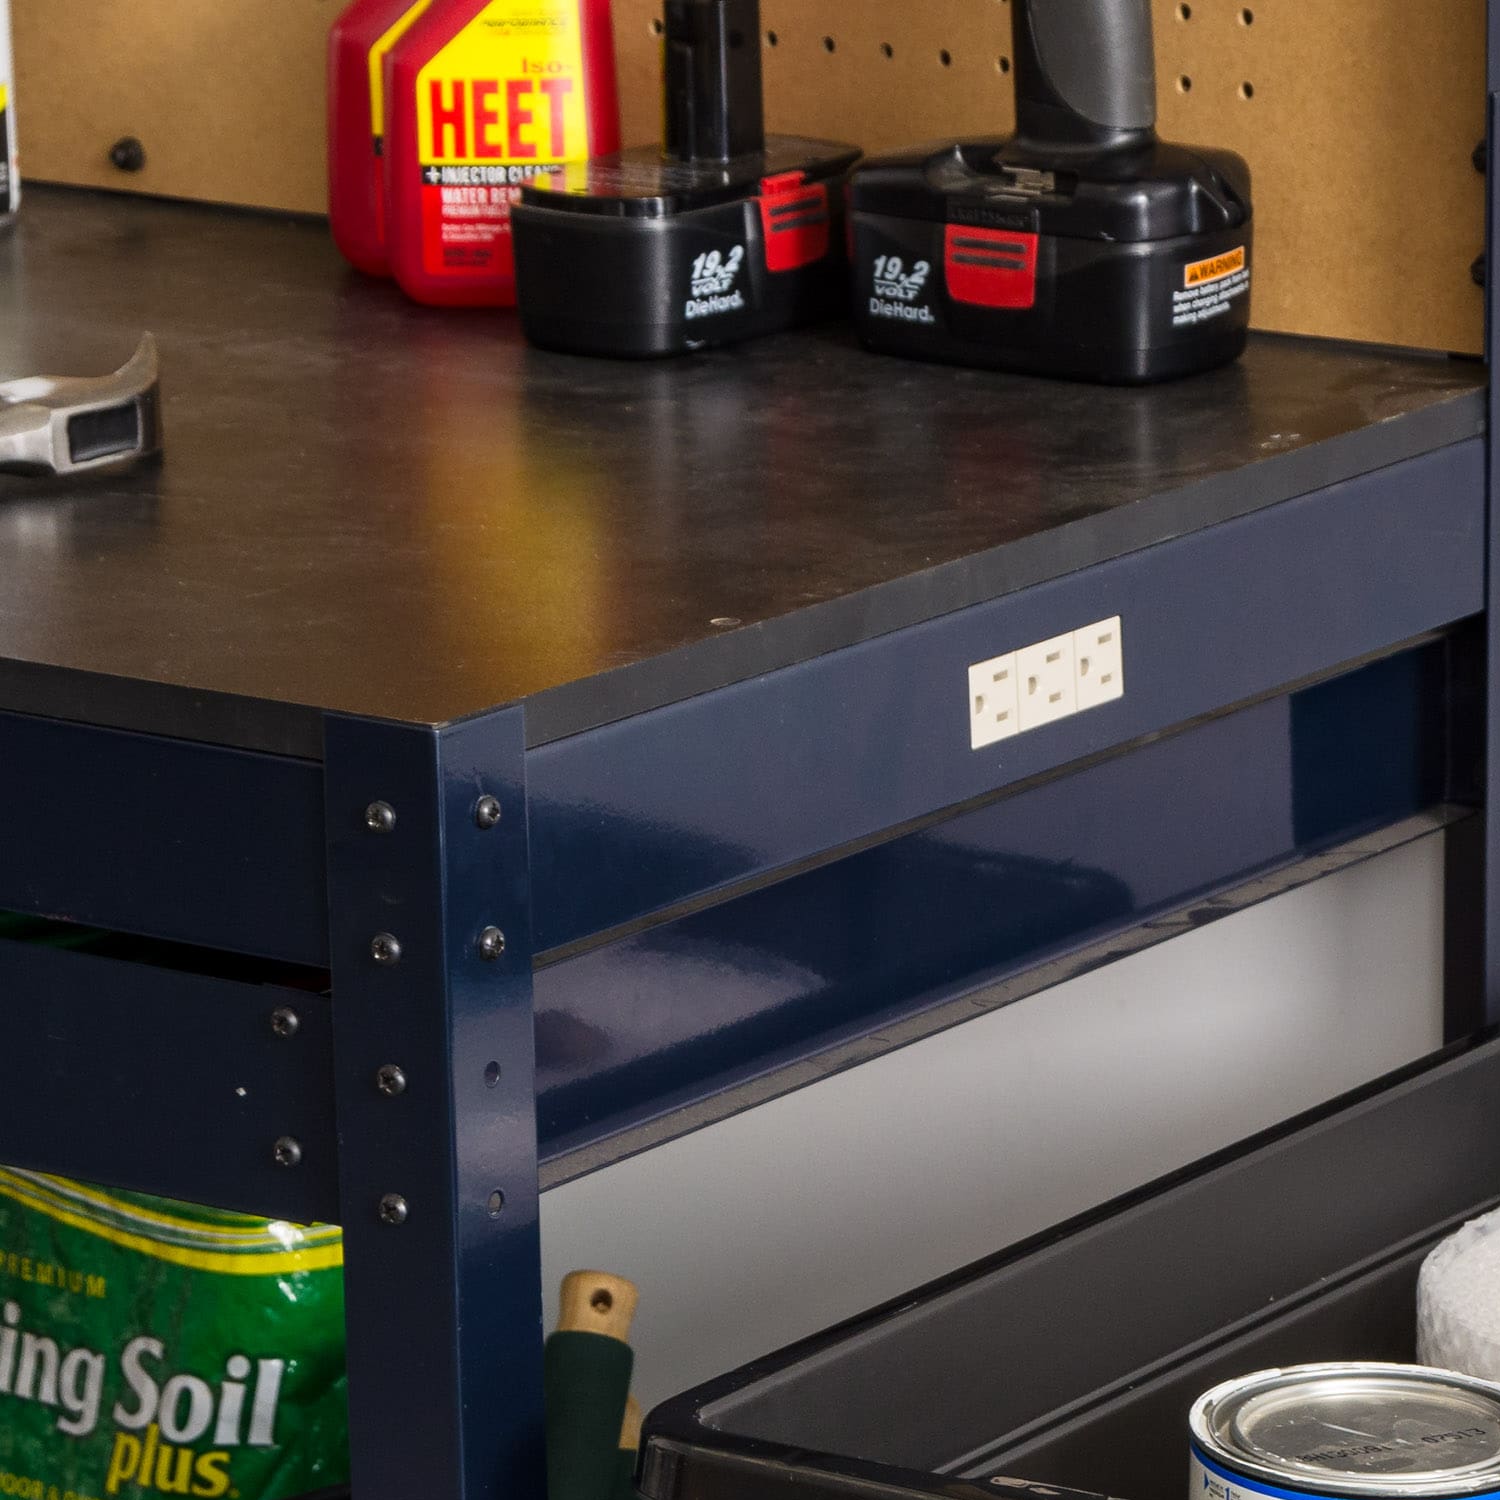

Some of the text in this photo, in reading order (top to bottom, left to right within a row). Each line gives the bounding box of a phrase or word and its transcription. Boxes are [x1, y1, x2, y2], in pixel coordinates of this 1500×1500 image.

[429, 79, 573, 158] HEET
[441, 187, 487, 204] WATER
[691, 245, 744, 278] 19.2
[874, 254, 930, 285] 19.2
[1200, 249, 1242, 279] WARNING
[692, 277, 733, 297] VOLT
[875, 284, 919, 301] VOLT
[113, 1336, 284, 1447] Soil
